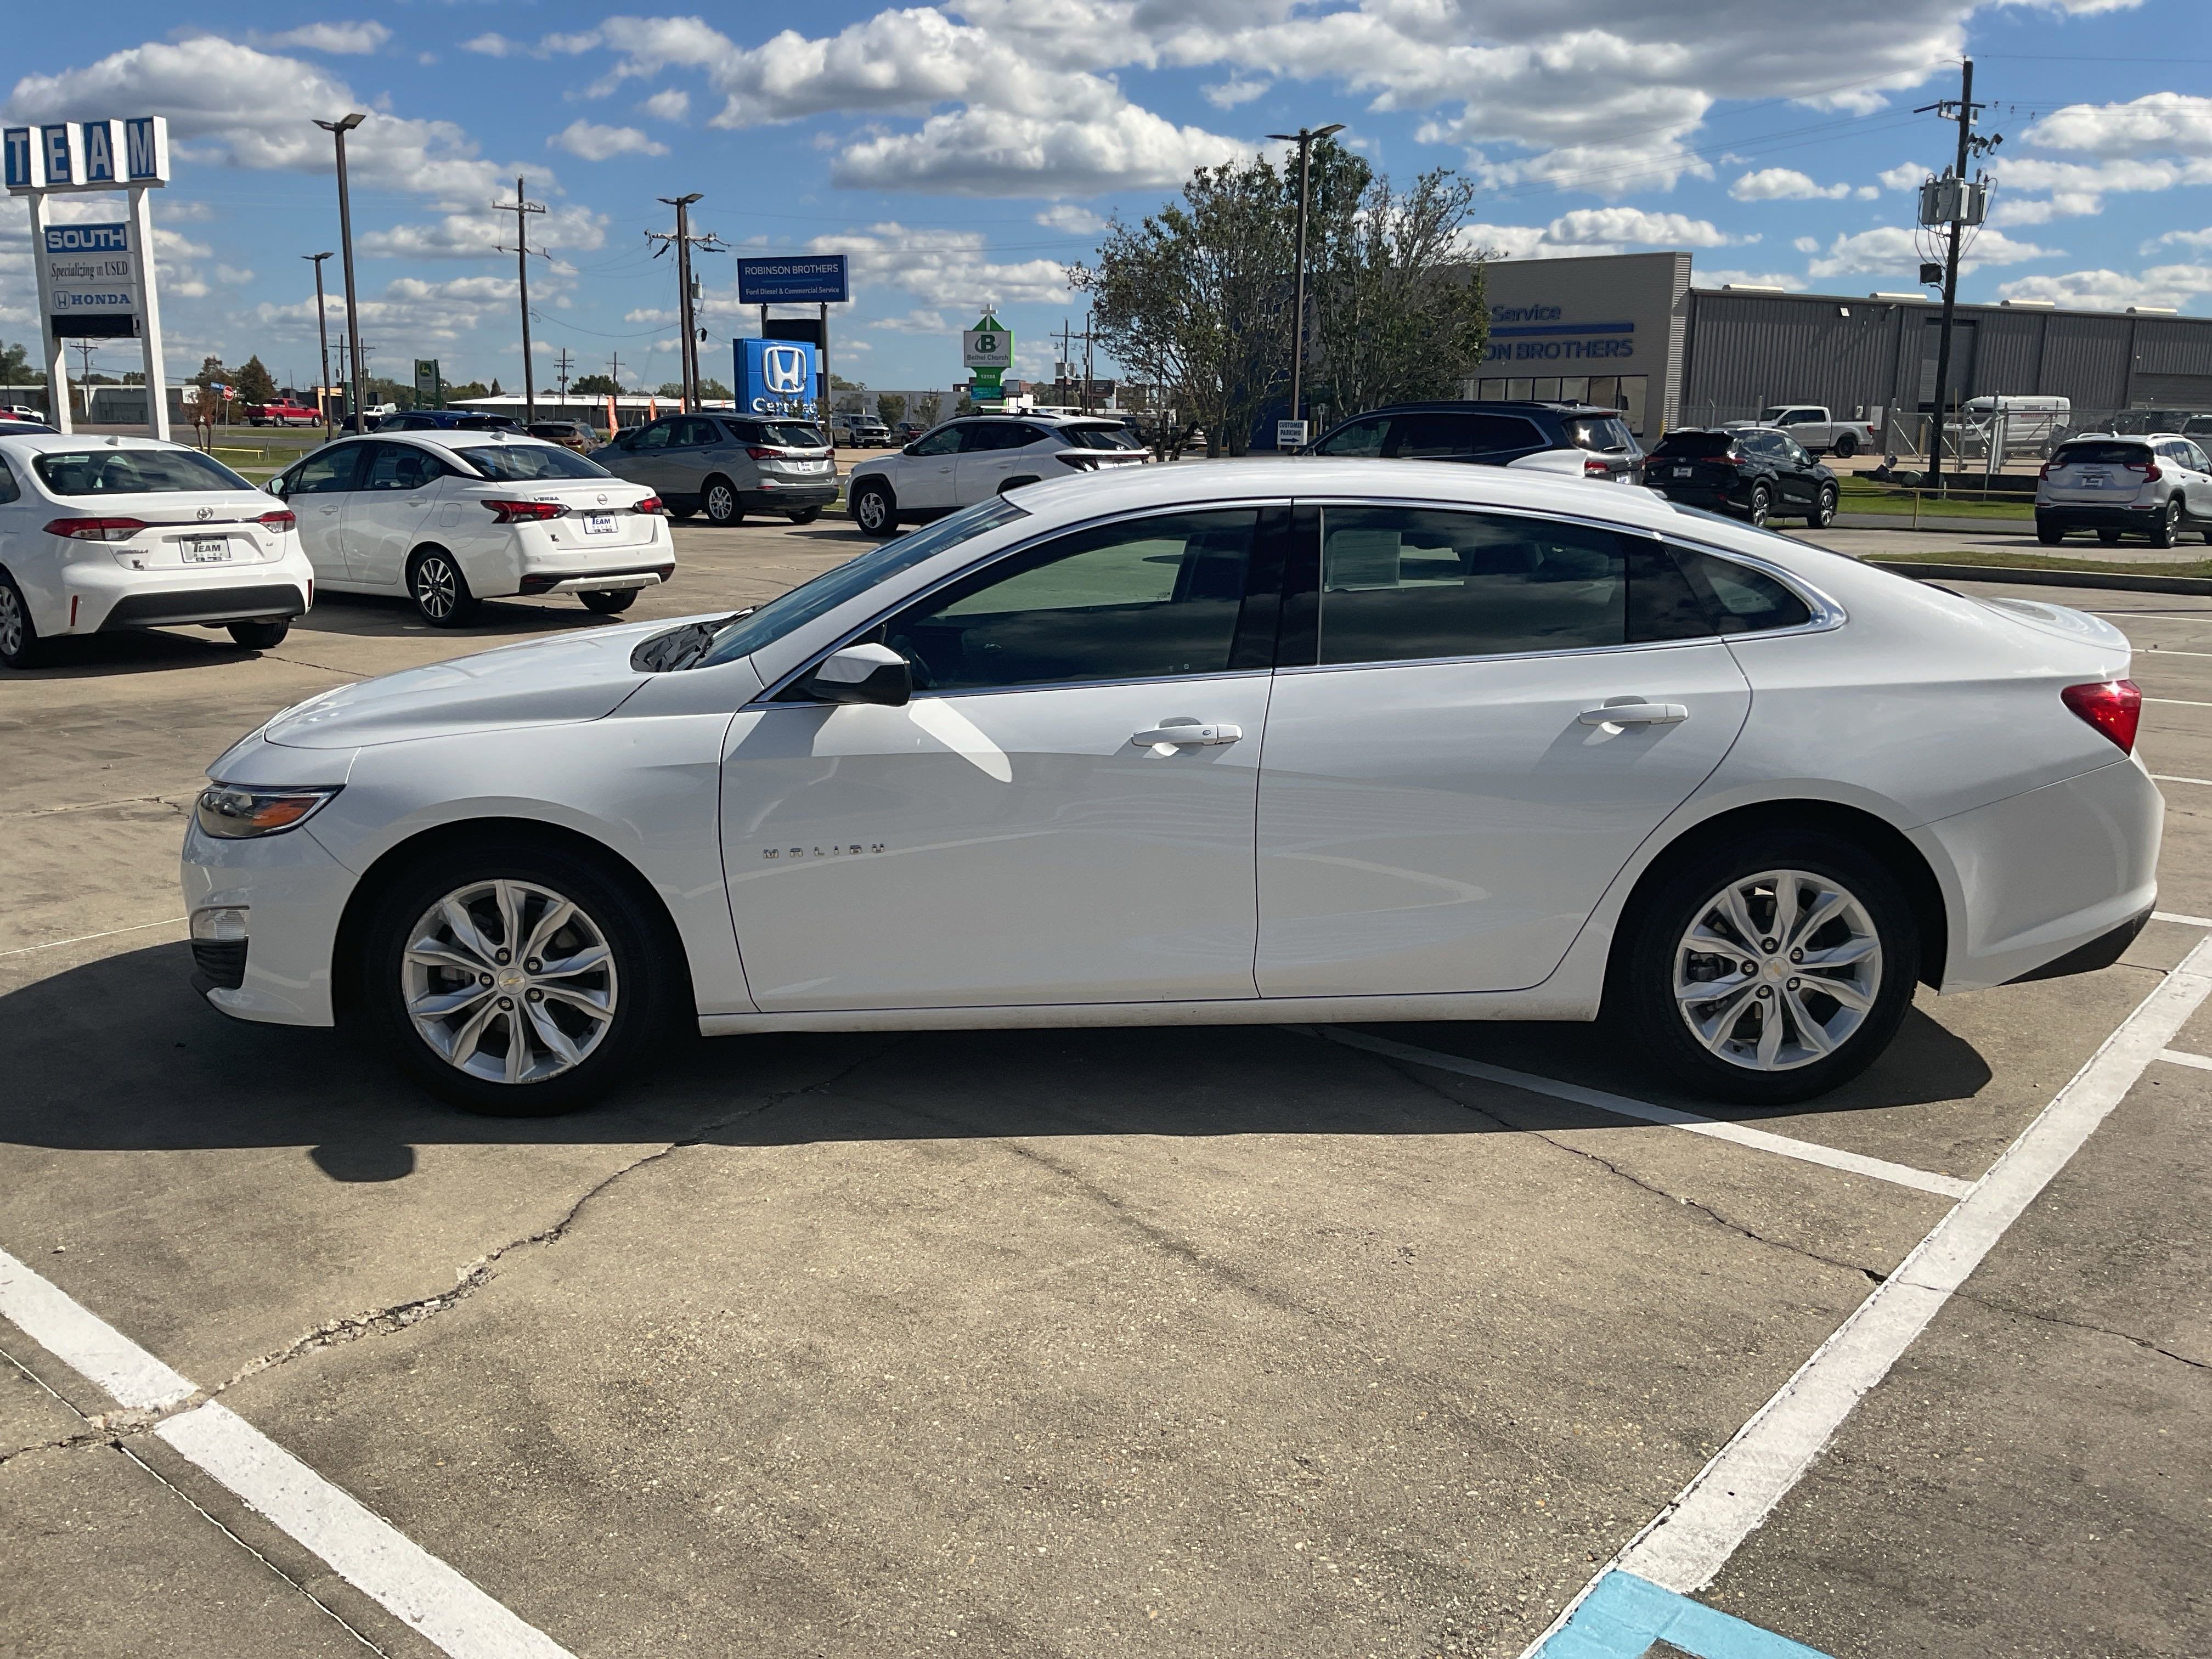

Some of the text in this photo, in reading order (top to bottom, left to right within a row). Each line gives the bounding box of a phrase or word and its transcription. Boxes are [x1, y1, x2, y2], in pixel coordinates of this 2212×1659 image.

[8, 122, 155, 182] TEAM
[48, 229, 126, 249] SOUTH
[52, 261, 128, 281] Specializing in USED
[745, 264, 839, 275] ROBINSON BROTHERS
[785, 286, 817, 295] Commercial
[71, 294, 131, 305] HONDA
[1492, 304, 1561, 323] Service
[1516, 338, 1634, 360] BROTHERS
[752, 398, 817, 414] Certed
[590, 514, 610, 525] TEAM
[191, 540, 221, 552] TEAM
[763, 843, 885, 859] MALIBU
